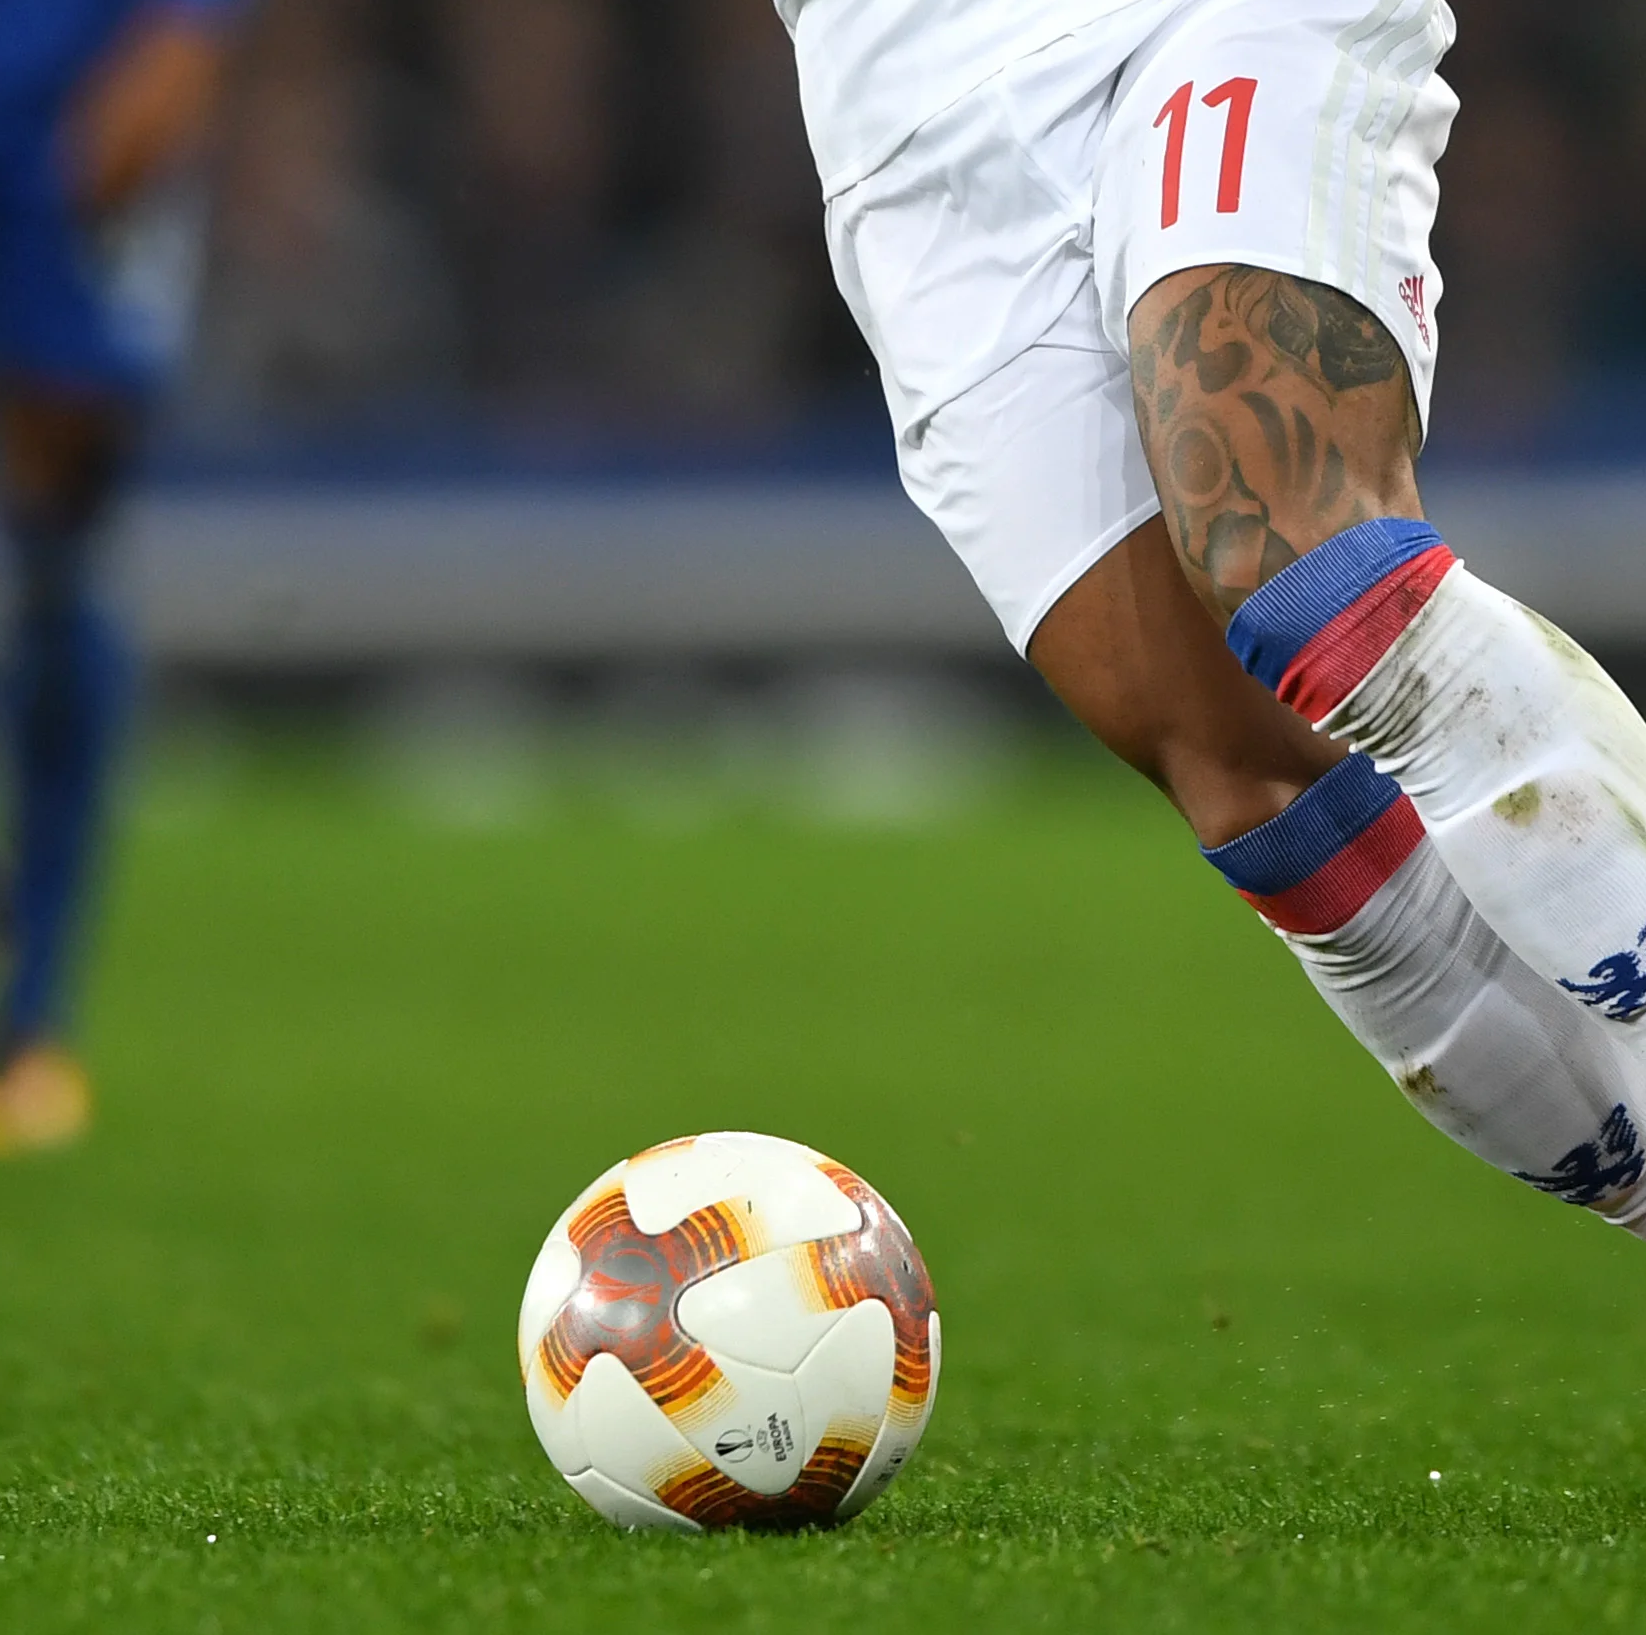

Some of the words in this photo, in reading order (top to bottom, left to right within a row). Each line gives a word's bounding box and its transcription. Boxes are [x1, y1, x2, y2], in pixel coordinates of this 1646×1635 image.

[1153, 76, 1258, 230] 11
[1398, 281, 1432, 352] adidas
[767, 1412, 787, 1462] EUROPA
